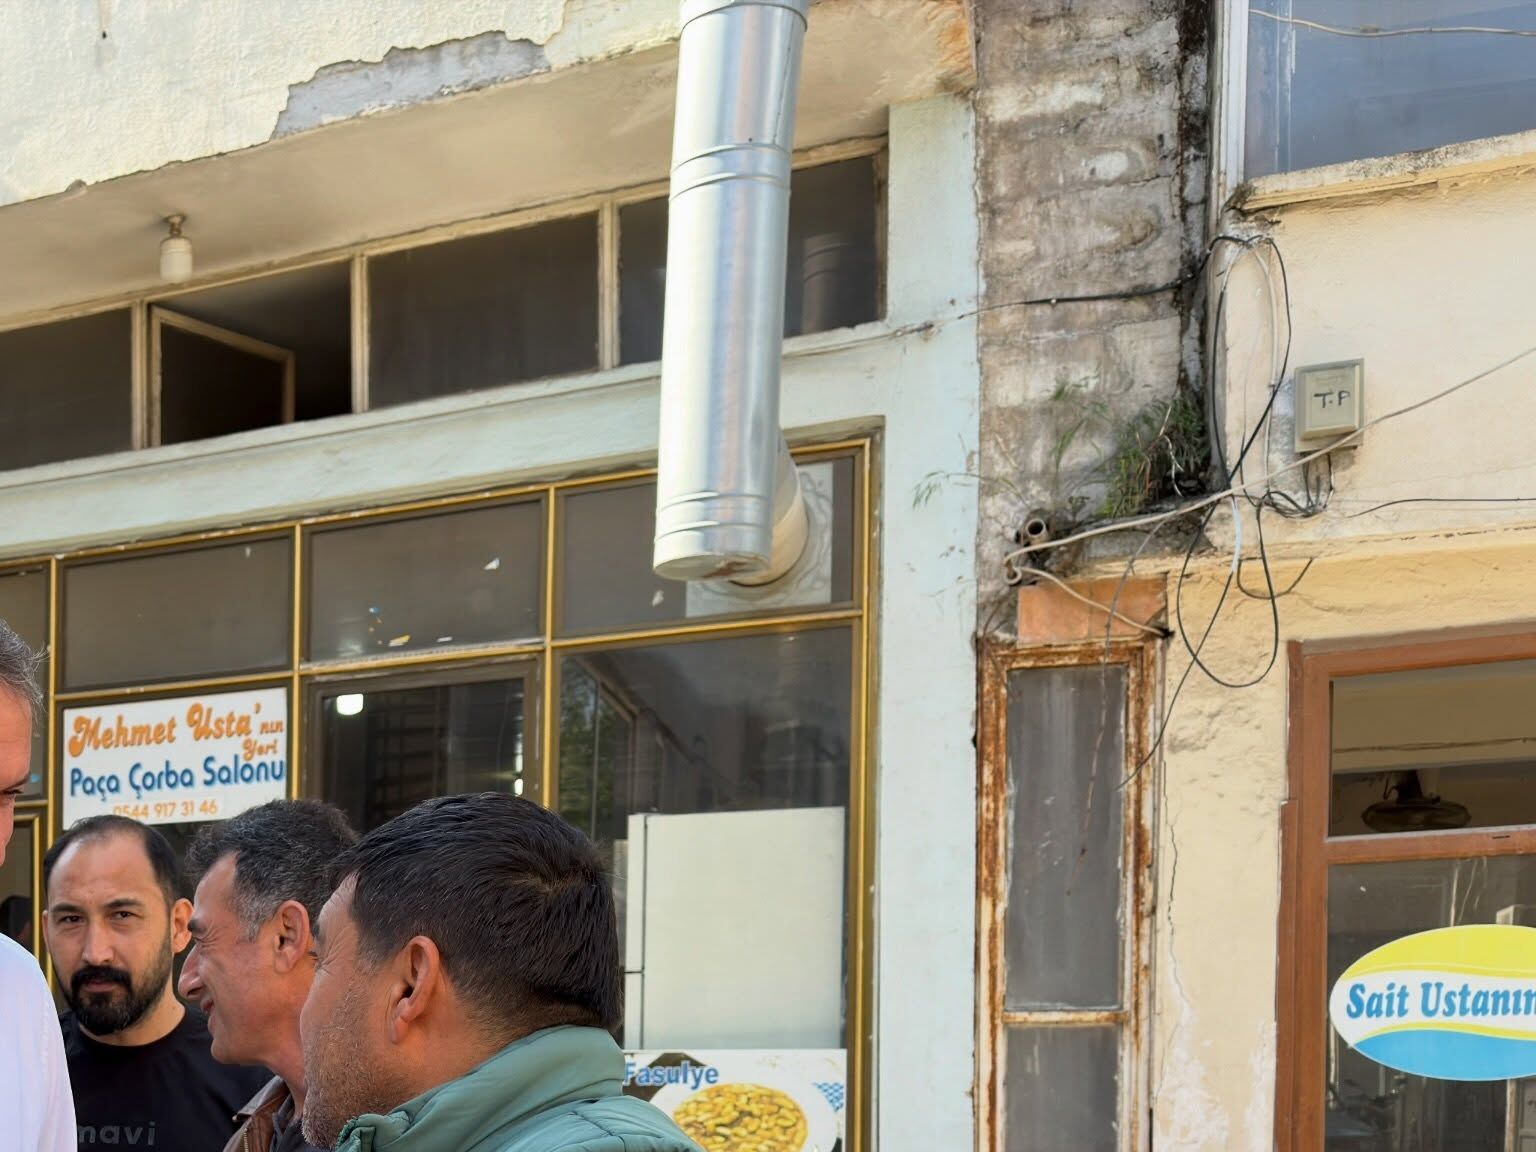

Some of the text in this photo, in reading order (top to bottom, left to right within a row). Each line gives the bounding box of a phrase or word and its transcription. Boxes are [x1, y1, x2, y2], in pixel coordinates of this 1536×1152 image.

[68, 714, 176, 758] Mehmet
[242, 738, 277, 761] Yeri
[70, 754, 285, 801] Paça Çorba Salonu
[154, 802, 176, 817] 917
[181, 801, 195, 816] 31
[200, 799, 217, 815] 46
[1346, 982, 1409, 1019] Sait
[623, 1061, 720, 1090] Fasulye
